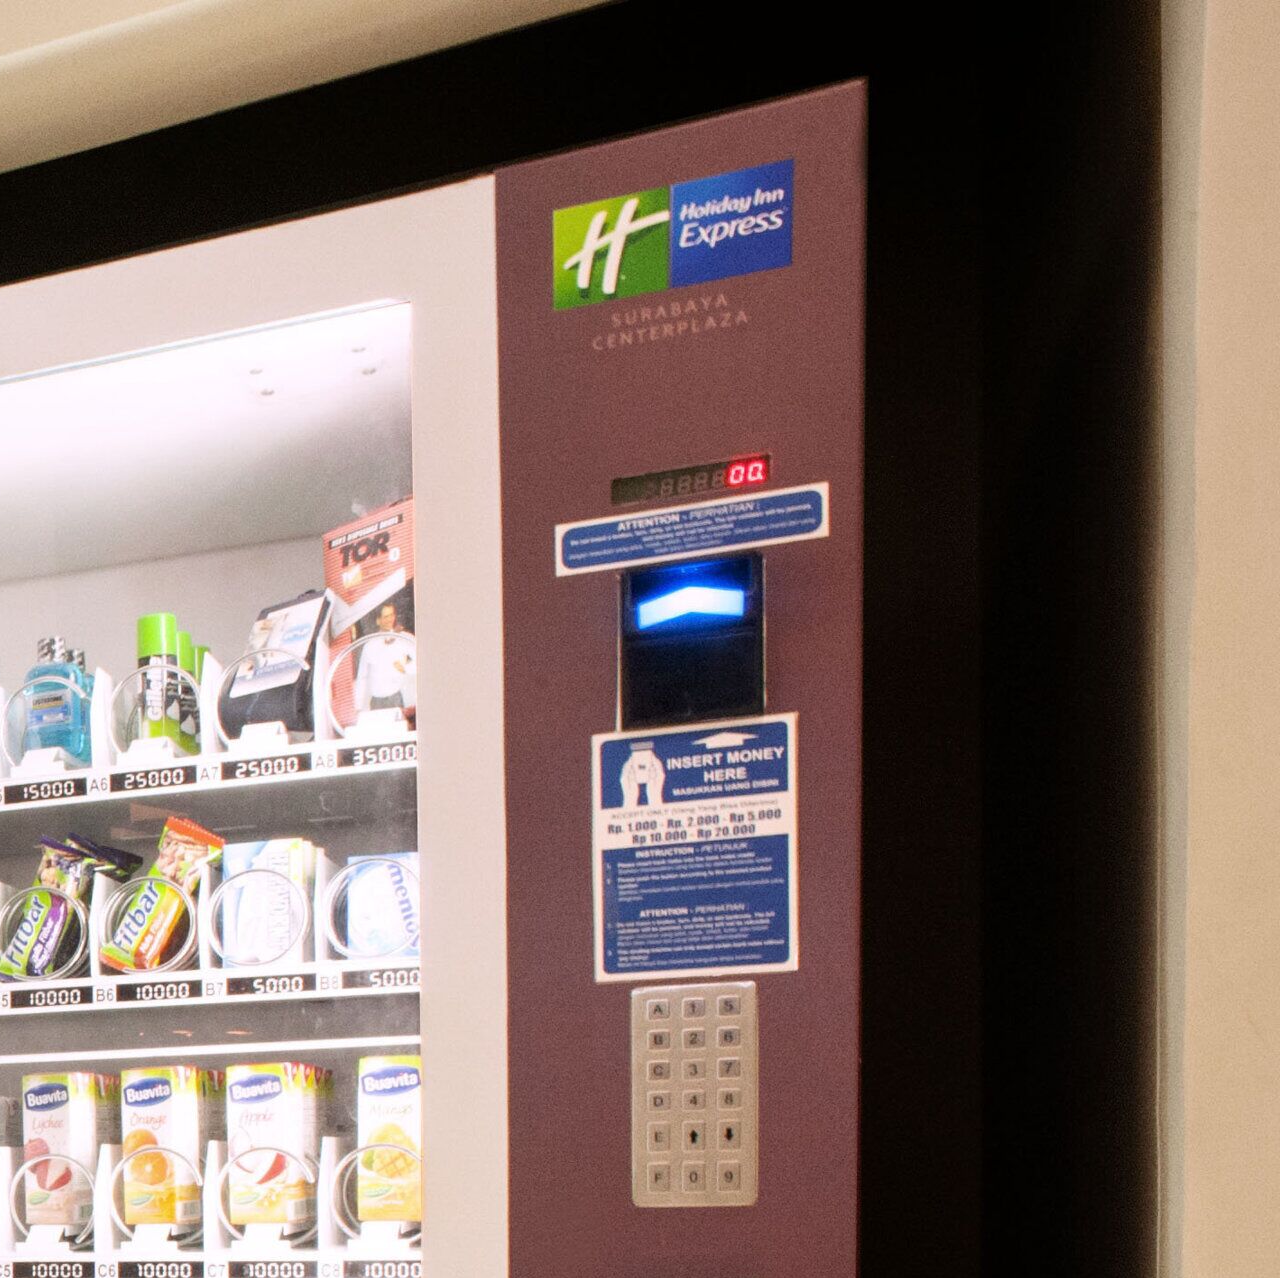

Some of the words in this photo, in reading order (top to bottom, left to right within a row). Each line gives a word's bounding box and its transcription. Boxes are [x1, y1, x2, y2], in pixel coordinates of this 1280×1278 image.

[680, 194, 751, 221] Holiday
[754, 188, 784, 206] Inn
[679, 210, 784, 248] Express
[610, 293, 729, 328] SURABAYA
[592, 310, 749, 350] CENTERPLAZA
[617, 513, 681, 532] ATTENTION
[340, 531, 390, 568] TOR
[352, 744, 417, 767] 35000
[666, 752, 723, 771] INSERT
[727, 746, 785, 764] MONEY
[200, 766, 219, 781] A7
[234, 757, 300, 779] 25000
[704, 766, 748, 783] HERE
[23, 780, 76, 799] 15000
[89, 778, 108, 793] A6
[124, 768, 185, 790] 25000
[627, 820, 658, 832] 1.000
[687, 814, 721, 828] 2.000
[747, 808, 782, 822] 5.000
[632, 834, 647, 845] Rp
[650, 830, 688, 843] 10.000
[697, 828, 712, 840] Rp
[714, 824, 757, 837] 20.000
[112, 879, 161, 955] Fitbar
[206, 982, 224, 996] B7
[252, 976, 304, 994] 5000
[369, 969, 420, 988] 5000
[29, 988, 82, 1007] 10000
[96, 988, 114, 1002] B6
[136, 982, 190, 1000] 10000
[653, 1004, 662, 1014] A
[690, 1001, 696, 1012] 1
[724, 1000, 733, 1011] 5
[689, 1033, 699, 1044] 2
[724, 1032, 733, 1043] 6
[653, 1065, 663, 1077] C
[689, 1064, 698, 1076] 3
[724, 1062, 734, 1074] 7
[231, 1079, 281, 1100] Buavita
[363, 1071, 419, 1092] Buavita
[27, 1089, 68, 1107] Buavita
[126, 1084, 171, 1102] Buavita
[653, 1096, 664, 1107] D
[689, 1095, 699, 1107] 4
[654, 1131, 663, 1143] E
[654, 1172, 663, 1184] F
[689, 1171, 698, 1183] 0
[724, 1171, 733, 1183] 9
[98, 1264, 116, 1277] C6
[136, 1262, 192, 1278] 10000
[247, 1262, 305, 1278] 10000
[365, 1262, 421, 1278] 10000
